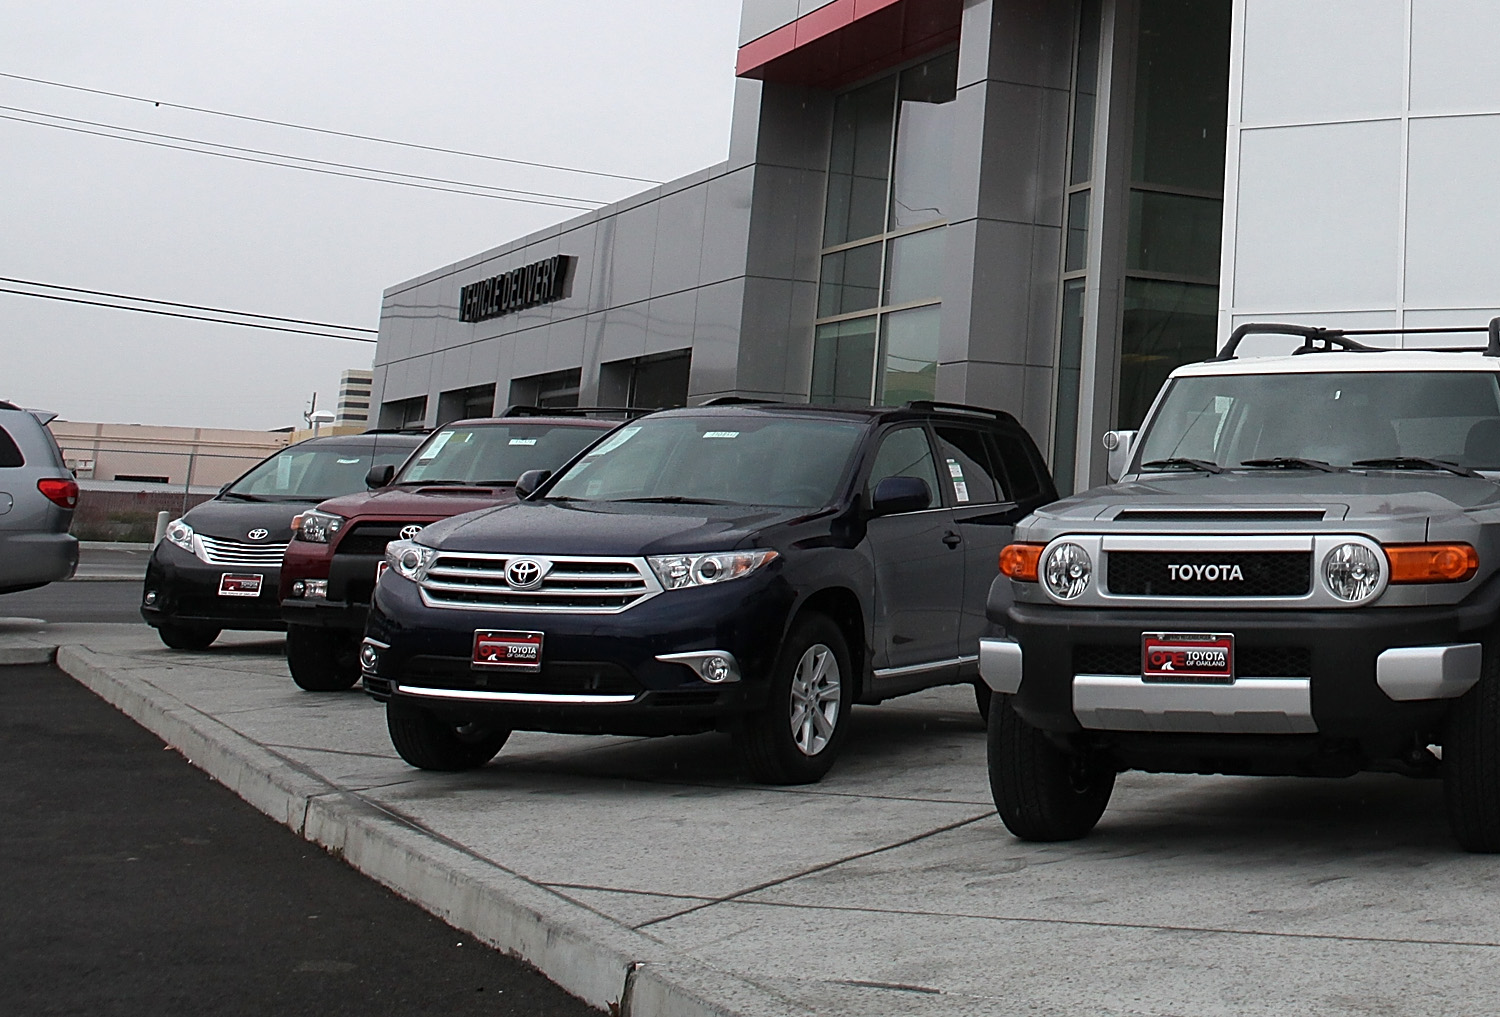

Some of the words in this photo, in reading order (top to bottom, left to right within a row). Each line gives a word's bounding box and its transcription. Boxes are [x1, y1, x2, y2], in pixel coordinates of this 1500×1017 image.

[501, 255, 567, 312] DELIVERY
[1167, 564, 1244, 581] TOYOTA
[508, 645, 536, 654] TOYOTA
[1186, 651, 1225, 661] TOYOTA
